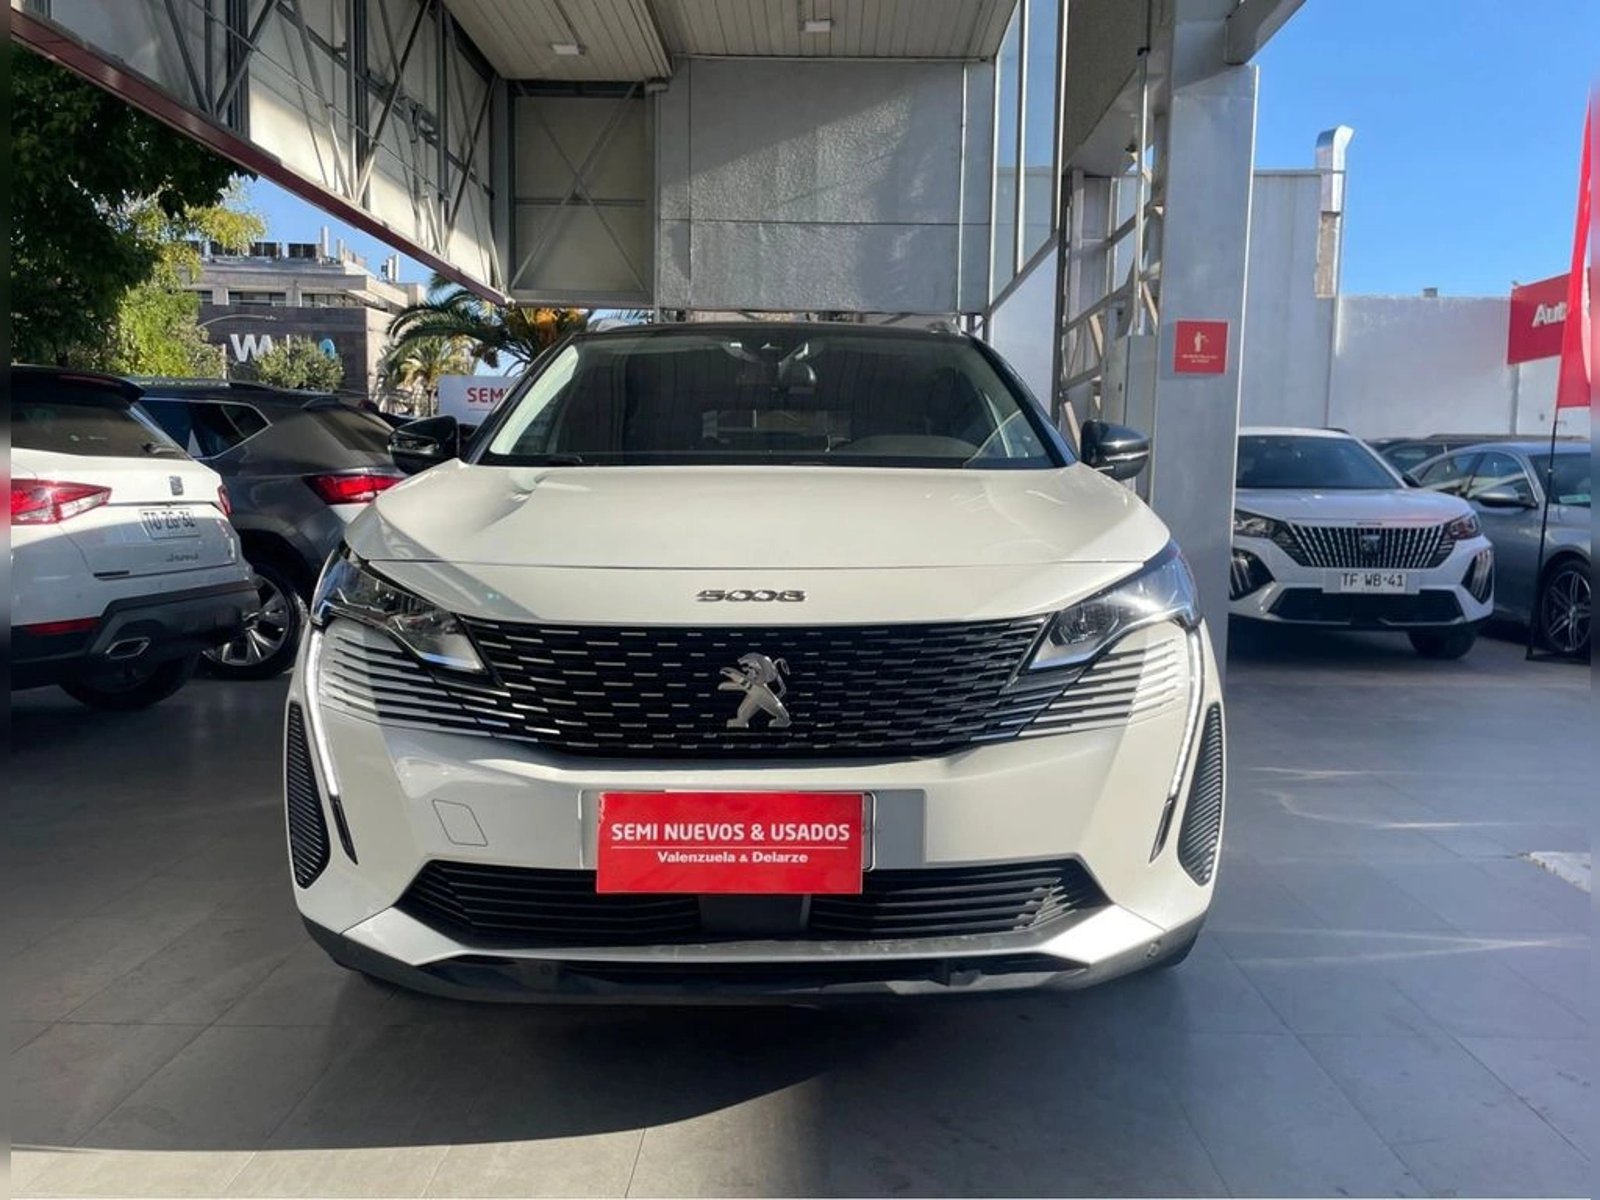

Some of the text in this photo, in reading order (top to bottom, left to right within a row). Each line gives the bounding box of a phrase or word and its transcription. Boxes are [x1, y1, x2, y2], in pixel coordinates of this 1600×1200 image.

[1531, 301, 1568, 328] Aut
[467, 387, 509, 403] SEM
[696, 590, 805, 602] 5008
[611, 823, 850, 841] SEMI NUEVOS & USADOS
[657, 851, 808, 864] Valenzuela & Delarze
